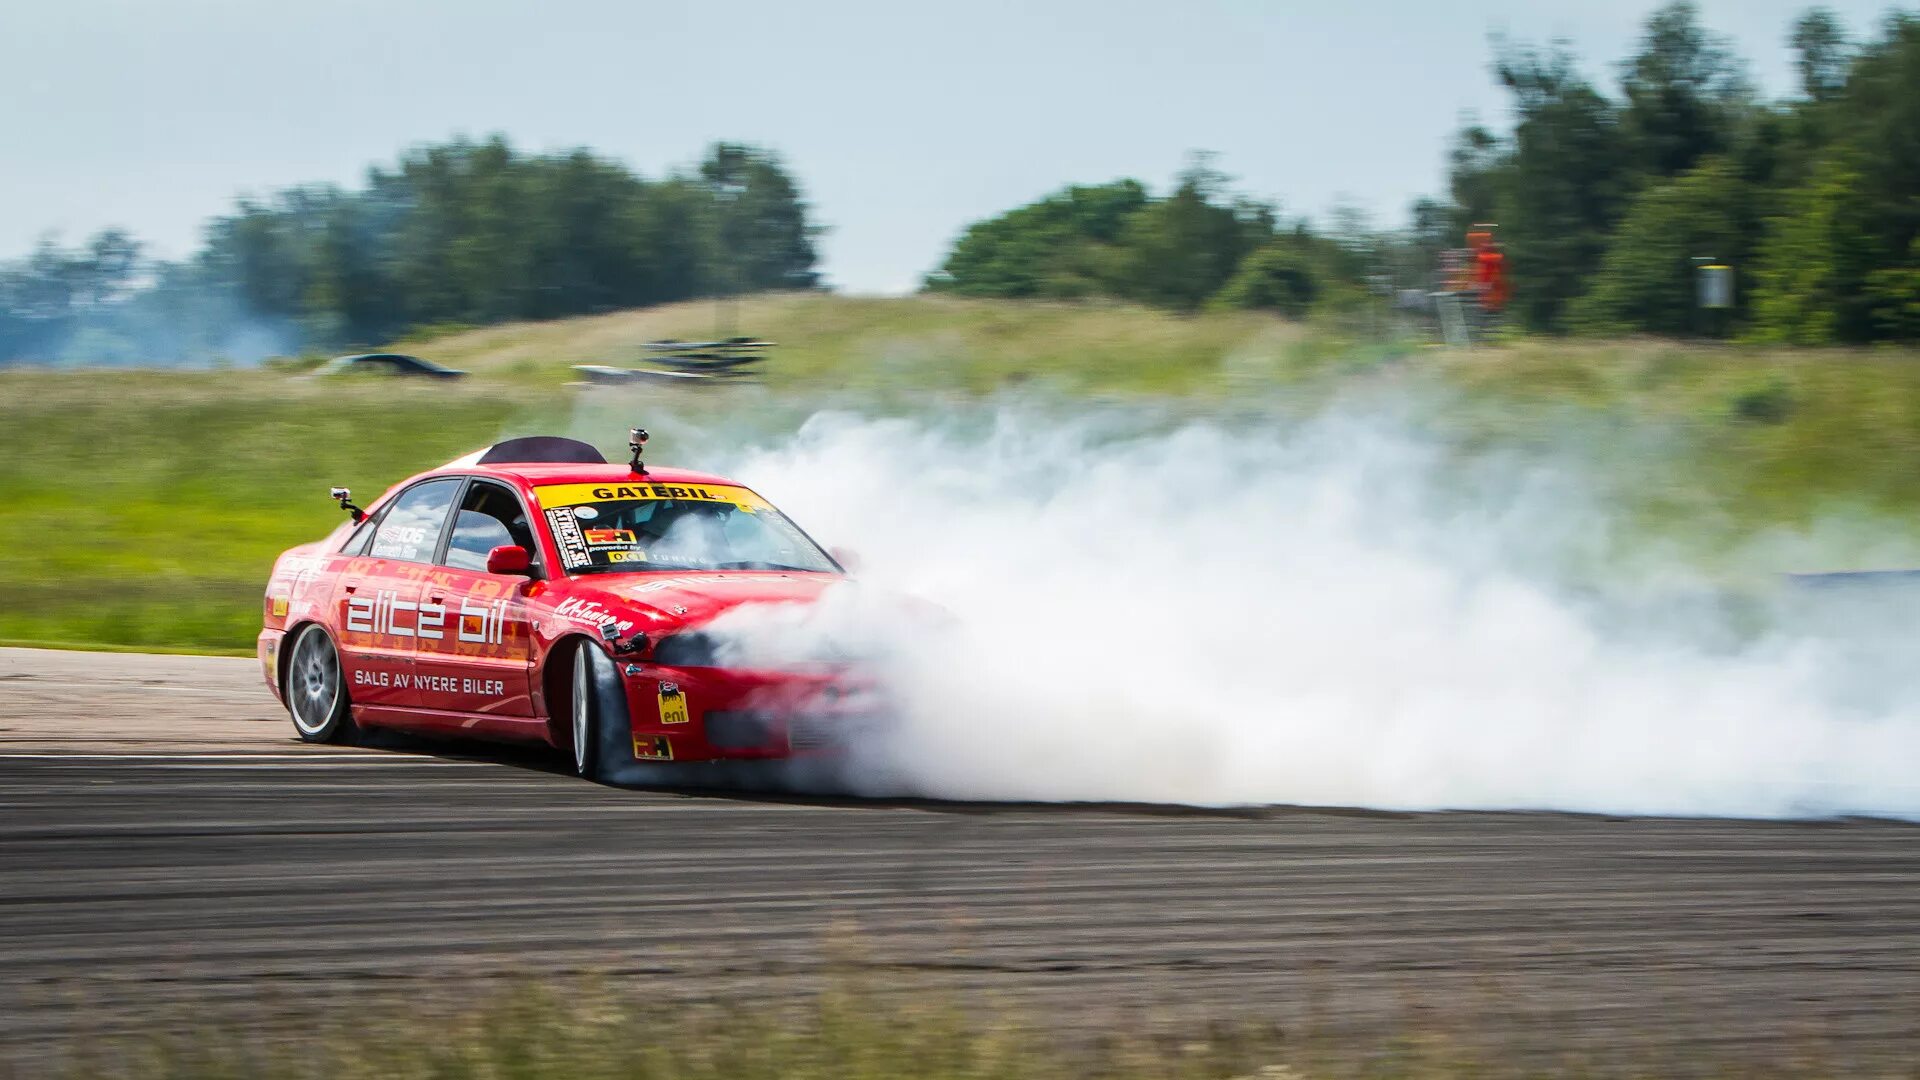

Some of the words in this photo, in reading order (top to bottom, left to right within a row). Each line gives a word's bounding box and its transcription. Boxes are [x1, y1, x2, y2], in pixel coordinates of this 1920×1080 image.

[592, 486, 715, 500] GATEBIL
[588, 544, 628, 553] powered
[629, 544, 641, 552] by
[458, 597, 507, 645] bil
[355, 670, 389, 687] SALG
[393, 674, 410, 689] AV
[414, 675, 458, 692] NYERE
[463, 678, 504, 696] BILER
[663, 704, 686, 723] eni
